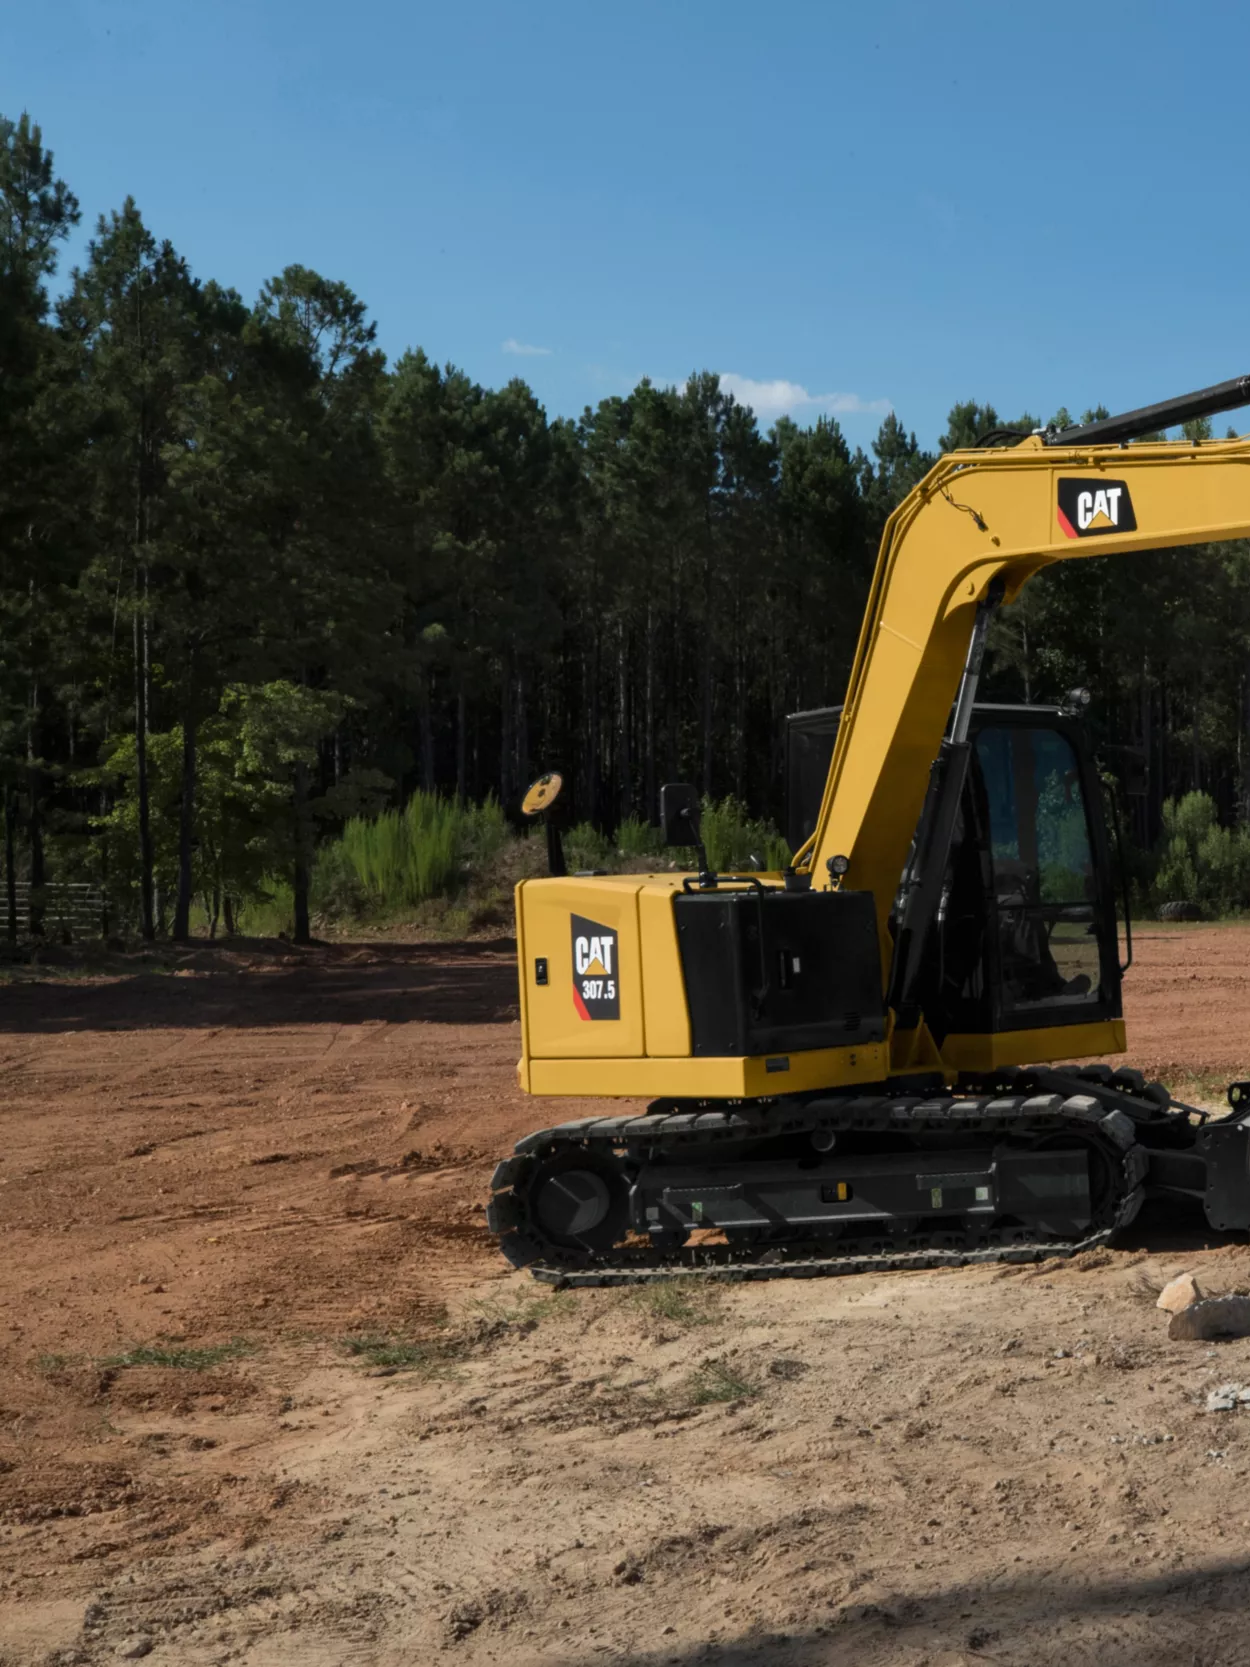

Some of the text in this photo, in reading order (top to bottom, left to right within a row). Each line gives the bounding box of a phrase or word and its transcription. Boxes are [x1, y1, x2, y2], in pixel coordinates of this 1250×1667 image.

[1077, 487, 1122, 529] CAT
[575, 936, 614, 975] CAT
[582, 980, 616, 1000] 307.5
